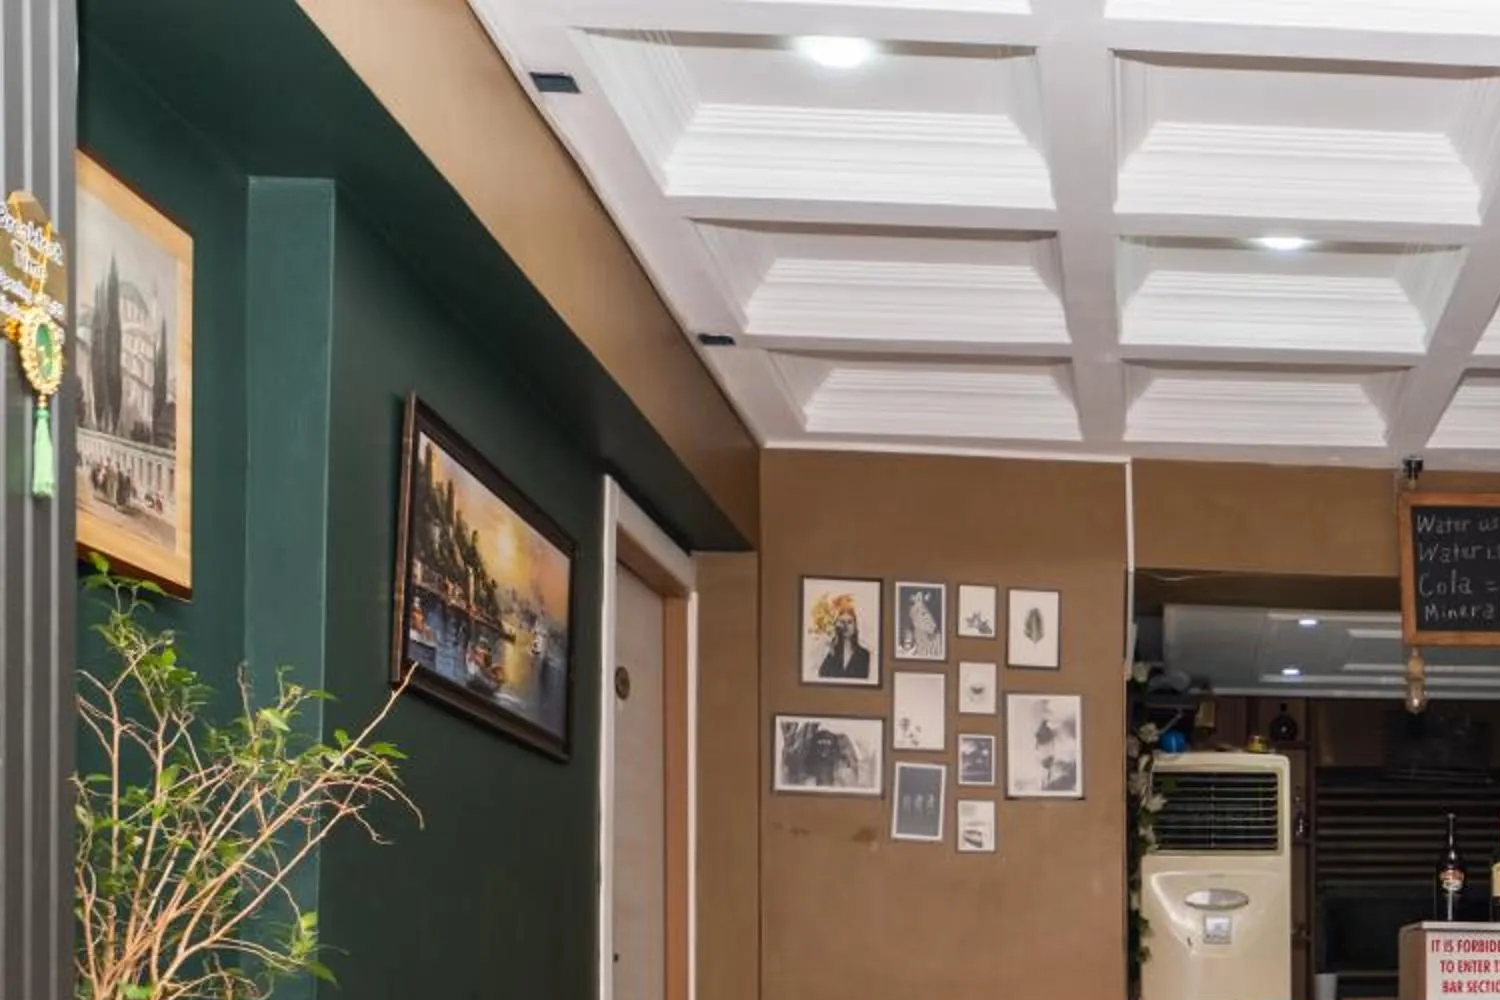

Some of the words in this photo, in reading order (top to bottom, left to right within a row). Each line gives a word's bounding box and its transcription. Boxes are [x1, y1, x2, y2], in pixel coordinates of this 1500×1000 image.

[1416, 513, 1472, 535] Water
[1418, 542, 1483, 564] Water
[1418, 569, 1473, 596] Cola
[1431, 939, 1441, 953] IT
[1444, 939, 1455, 953] IS
[1440, 960, 1454, 973] TO
[1458, 960, 1491, 973] ENTER
[1442, 980, 1463, 993] BAR
